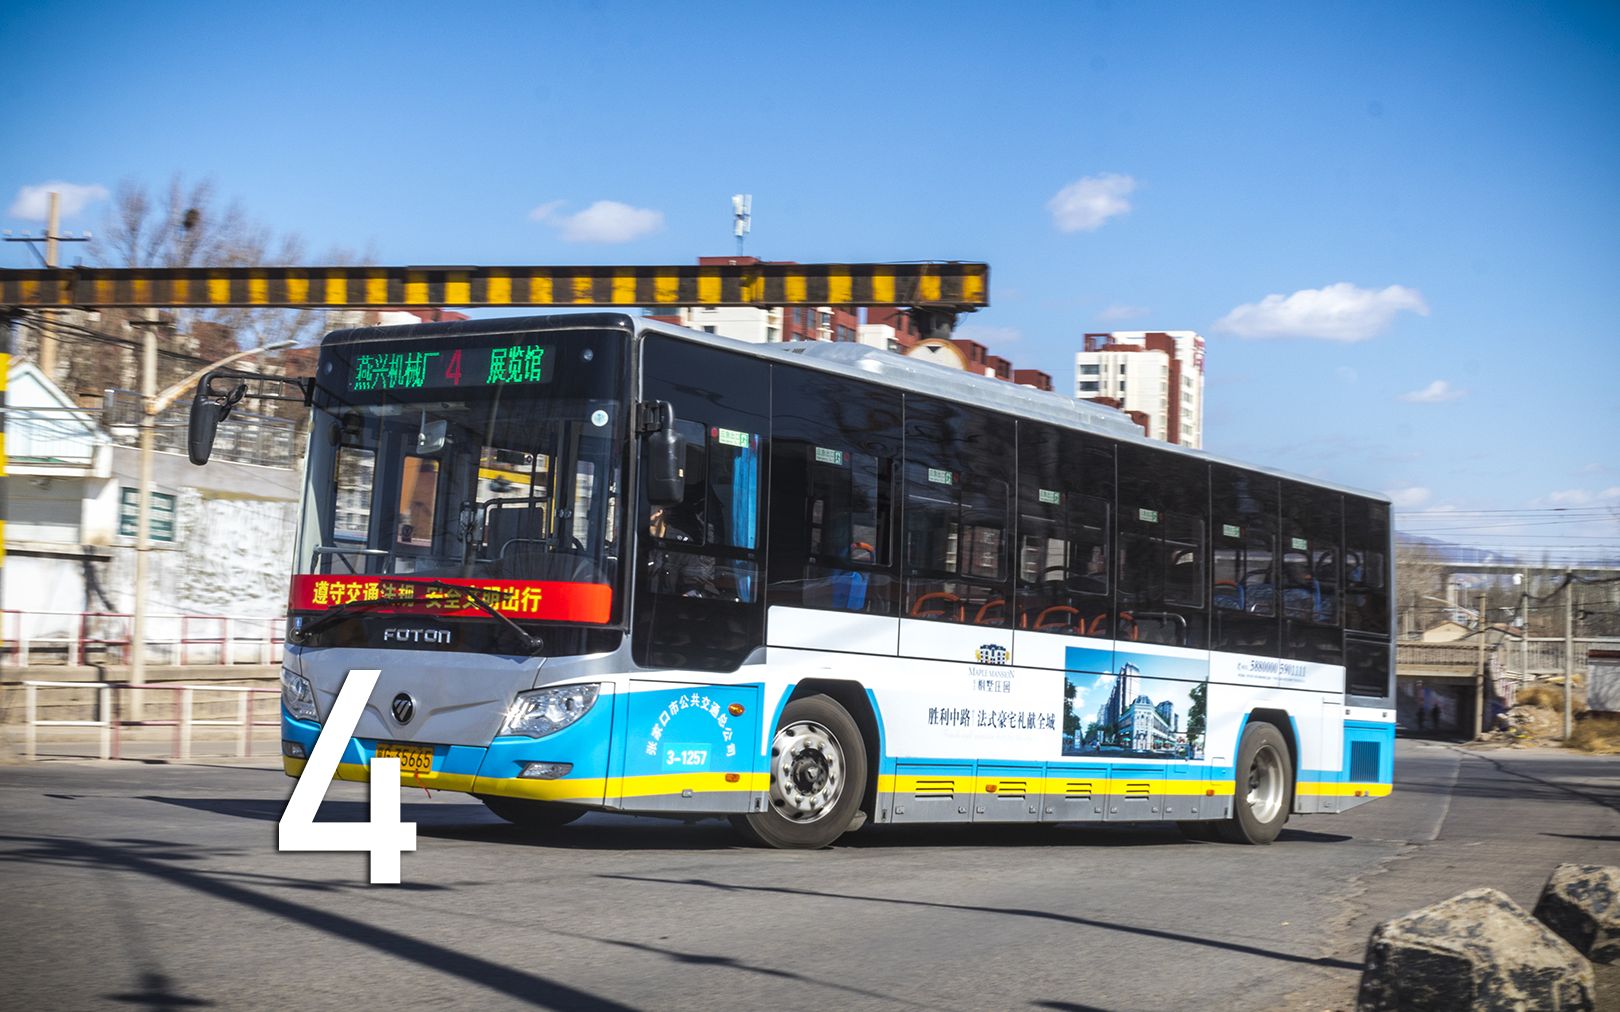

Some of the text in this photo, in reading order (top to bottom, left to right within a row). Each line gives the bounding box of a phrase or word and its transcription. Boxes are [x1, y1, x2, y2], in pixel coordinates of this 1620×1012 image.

[354, 345, 544, 390] 燕兴机械厂 4 展览馆
[384, 628, 451, 644] FOTON
[645, 692, 736, 757] 张家口市公共交通总公司
[928, 707, 1056, 731] 胜利中路 法式豪宅礼献全城
[666, 749, 707, 765] 3-1257
